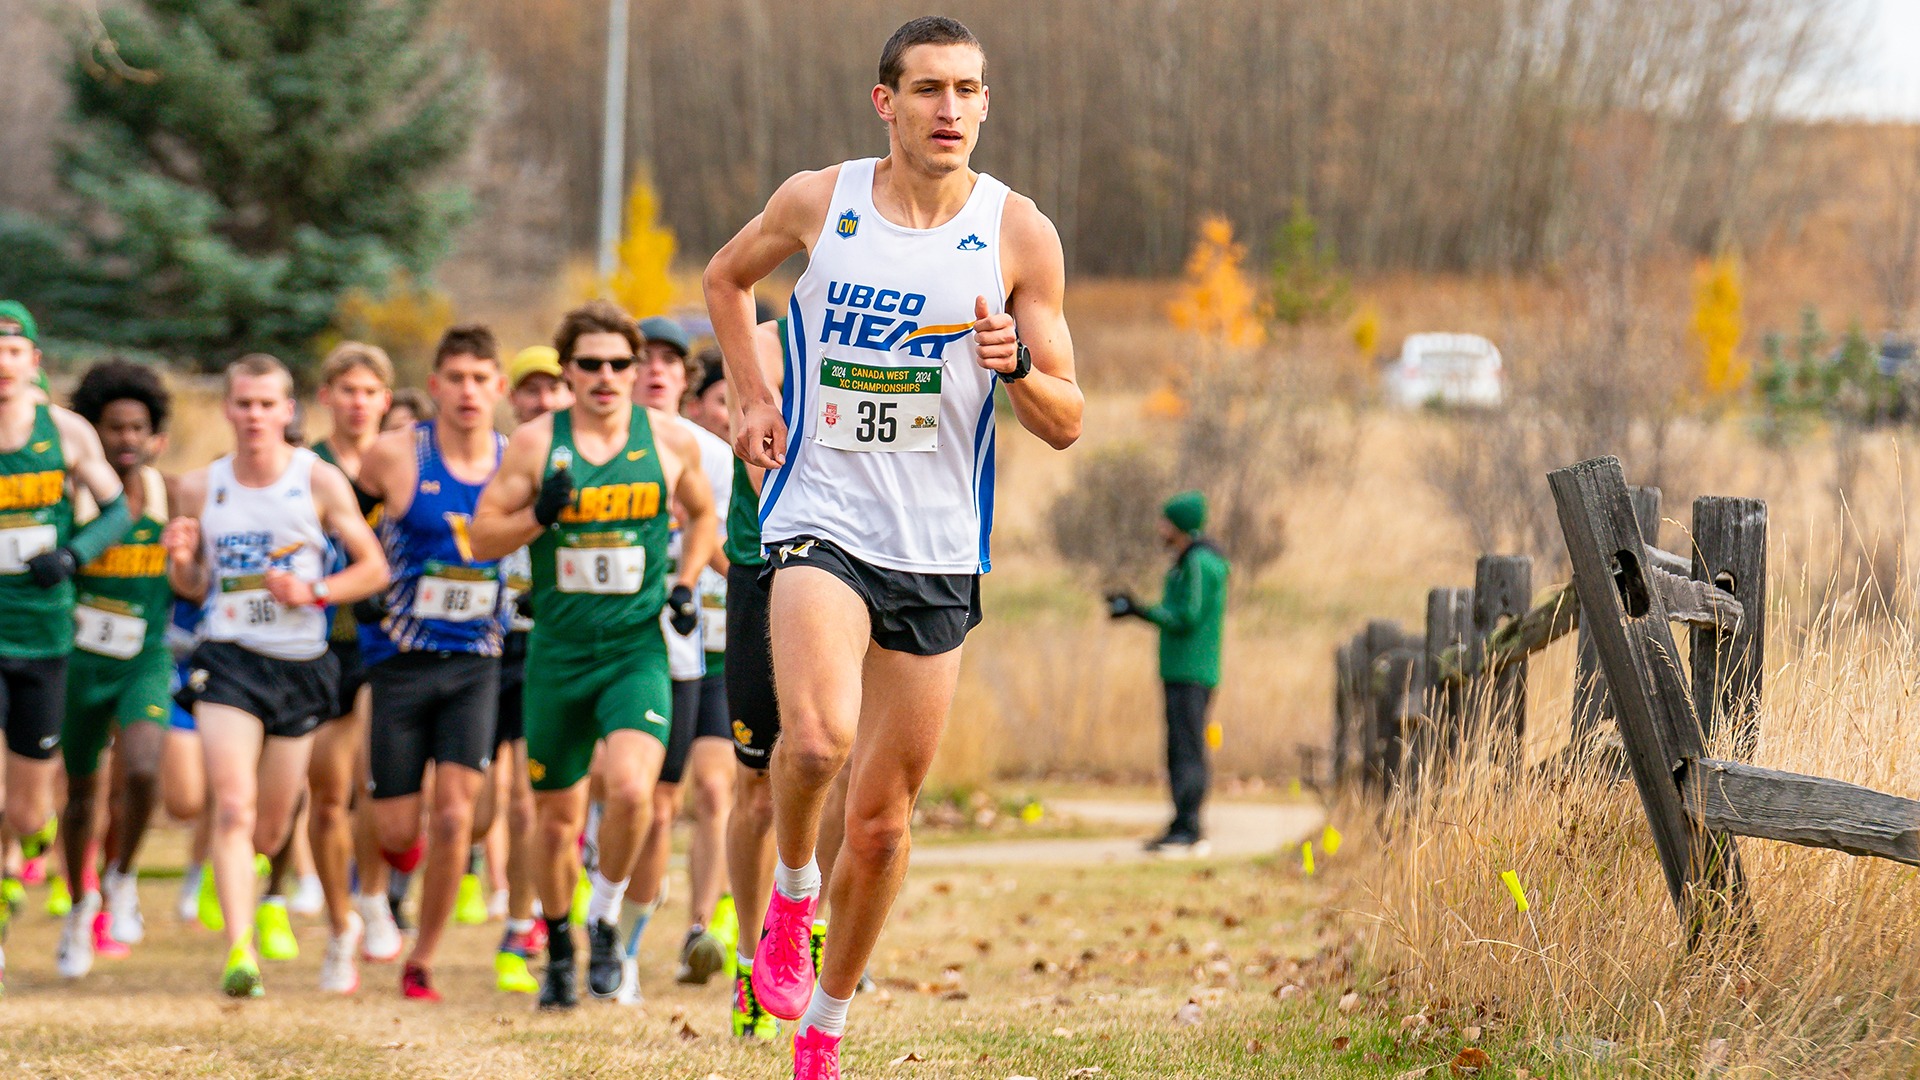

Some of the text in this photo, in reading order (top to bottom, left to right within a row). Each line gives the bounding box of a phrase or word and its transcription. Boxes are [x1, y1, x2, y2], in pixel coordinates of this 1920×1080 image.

[838, 218, 856, 234] CW
[826, 280, 927, 317] UBCO
[819, 308, 966, 360] HEAT
[831, 365, 932, 383] 2024 CANADA WEST 2024
[839, 378, 921, 393] XC CHAMPIONSHIPS
[856, 400, 898, 443] 35
[559, 481, 661, 523] LBERTA
[595, 554, 609, 584] 8
